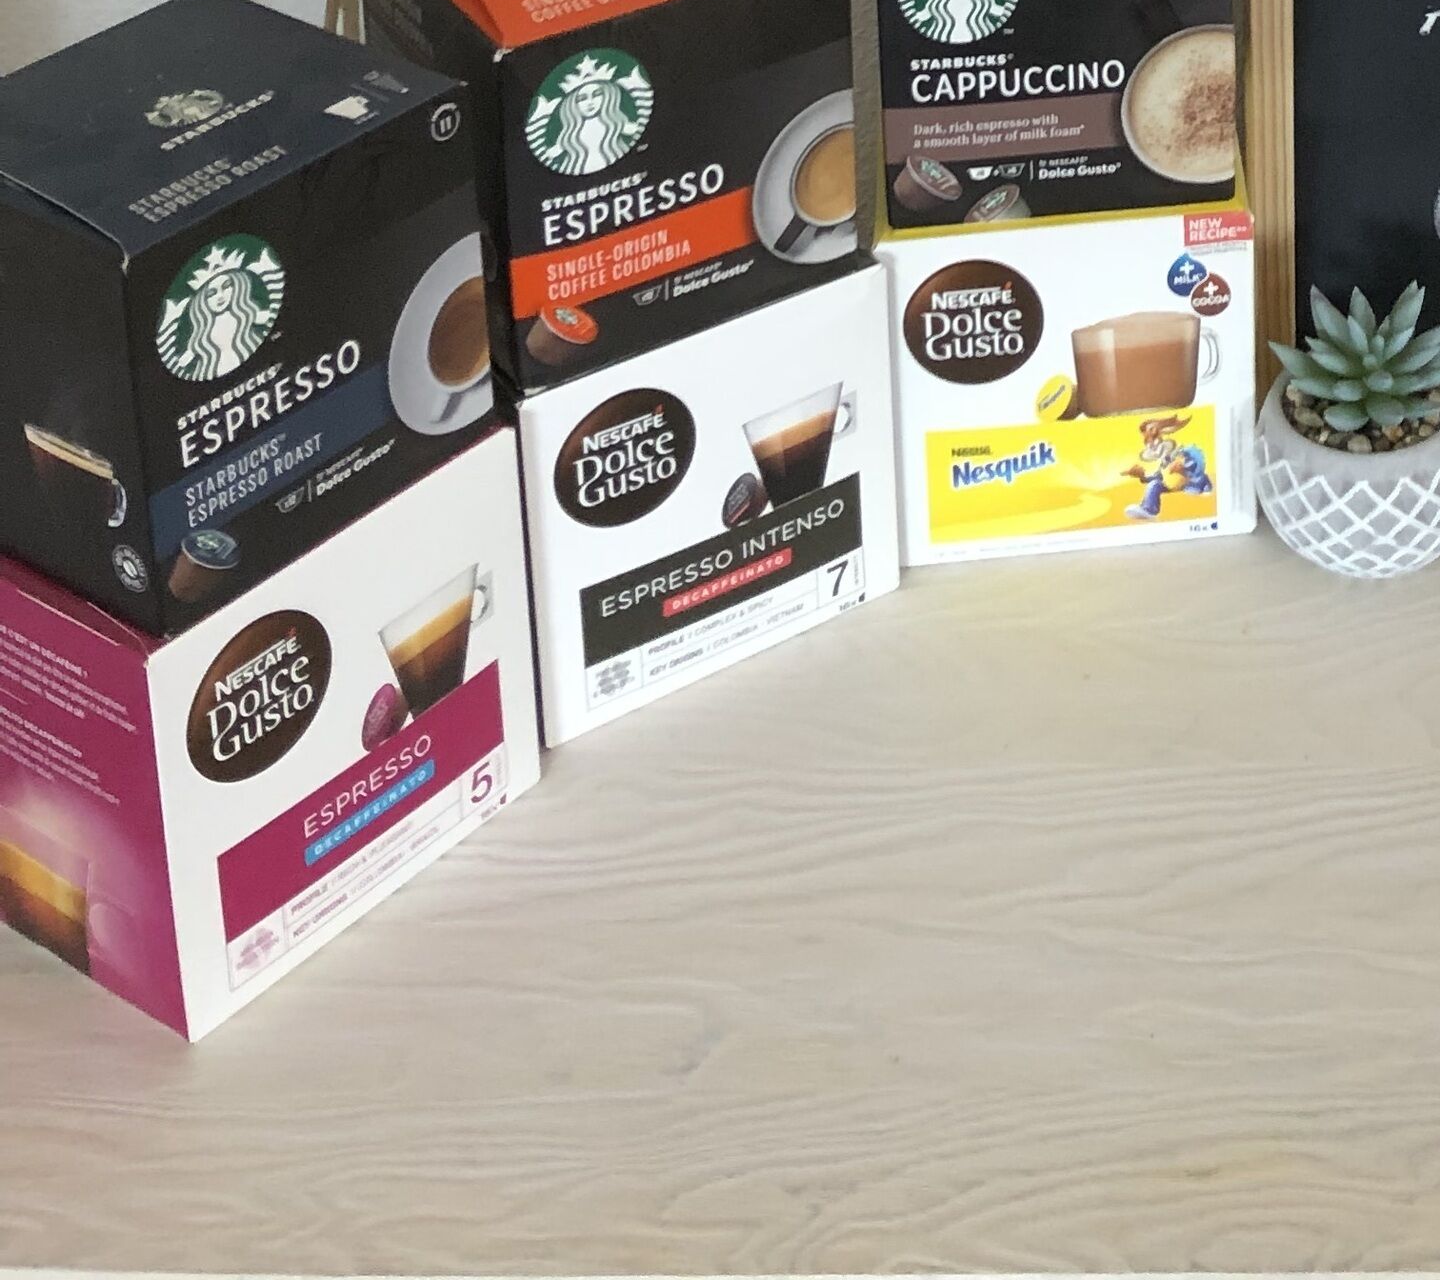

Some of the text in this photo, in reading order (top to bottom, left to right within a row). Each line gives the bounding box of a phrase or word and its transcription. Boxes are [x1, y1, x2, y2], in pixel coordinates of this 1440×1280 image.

[909, 53, 1014, 72] STARBUCKS
[911, 59, 1126, 104] CAPPUCCINO
[1032, 113, 1059, 127] with
[541, 174, 645, 212] STARBUCKS
[1038, 167, 1076, 180] Dolce
[543, 163, 725, 247] ESPRESSO
[1189, 217, 1223, 231] NEW
[547, 229, 668, 281] SINGLE-ORIGIN
[548, 240, 691, 301] COFFEE COLOMBIA
[931, 280, 1015, 311] NESCAFÉ
[920, 307, 1022, 339] Dolce
[925, 331, 1024, 361] Gusto
[177, 362, 283, 431] STARBUCKS
[179, 341, 361, 469] ESPRESSO
[582, 403, 667, 455] NESCAFÉ
[186, 433, 287, 507] STARBUCKS
[188, 433, 323, 528] ESPRESSO ROAST
[573, 430, 675, 486] Dolce
[578, 456, 678, 508] Gusto
[952, 441, 1055, 489] Nesquik
[602, 549, 733, 618] ESPRESSO
[741, 499, 845, 558] INTENSO
[671, 555, 785, 610] DECAFFEINATO
[826, 559, 849, 597] 7
[214, 626, 302, 702] NESCAFÉ
[206, 656, 310, 740] Dolce
[213, 683, 314, 761] Gusto
[303, 734, 432, 839] ESPRESSO
[470, 761, 493, 804] 5
